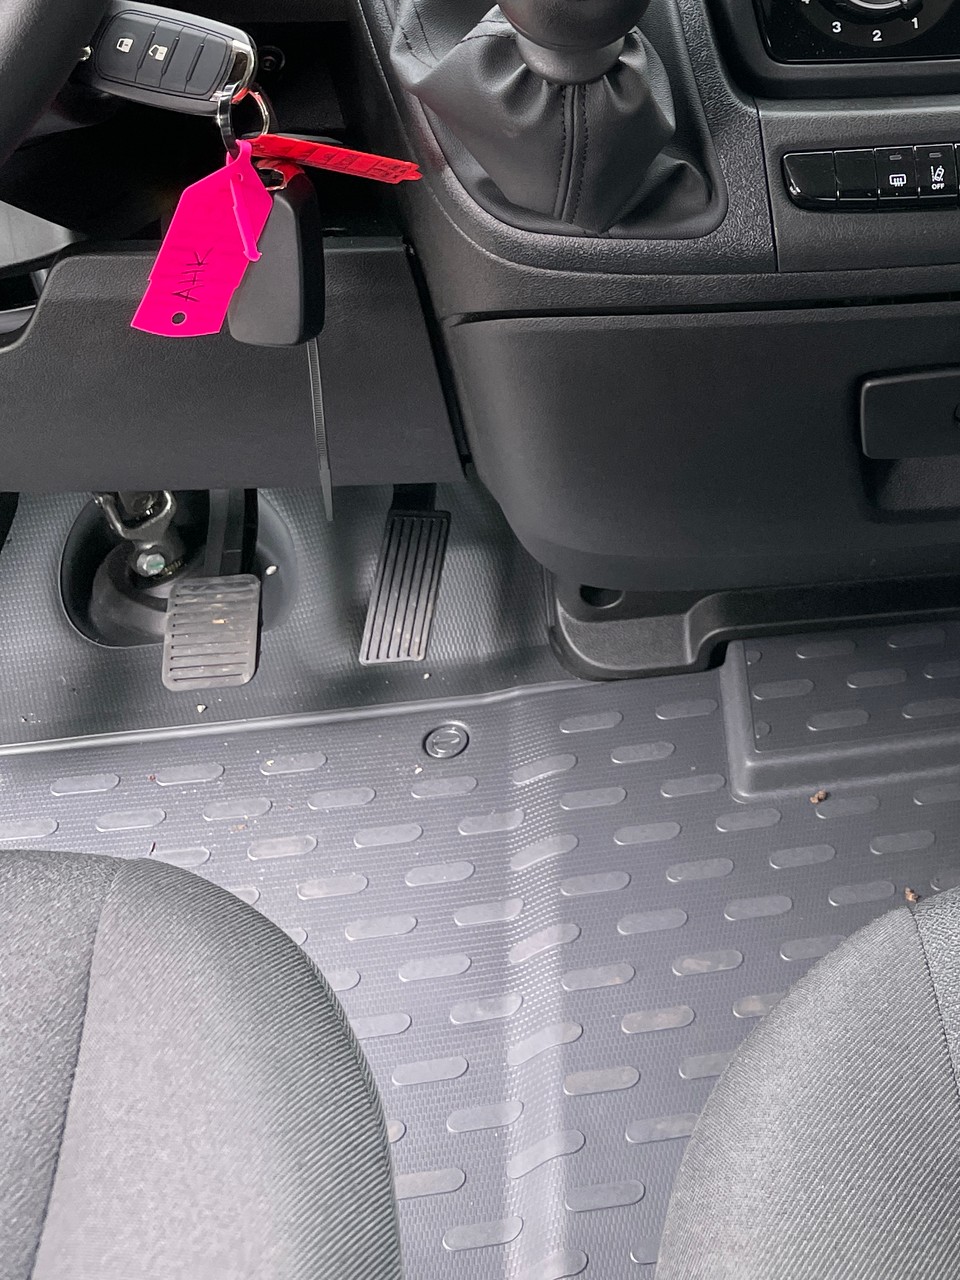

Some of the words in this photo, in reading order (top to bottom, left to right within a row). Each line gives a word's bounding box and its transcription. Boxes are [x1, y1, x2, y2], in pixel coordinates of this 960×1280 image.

[832, 21, 842, 33] 3
[912, 17, 919, 29] 1
[872, 30, 883, 42] 2
